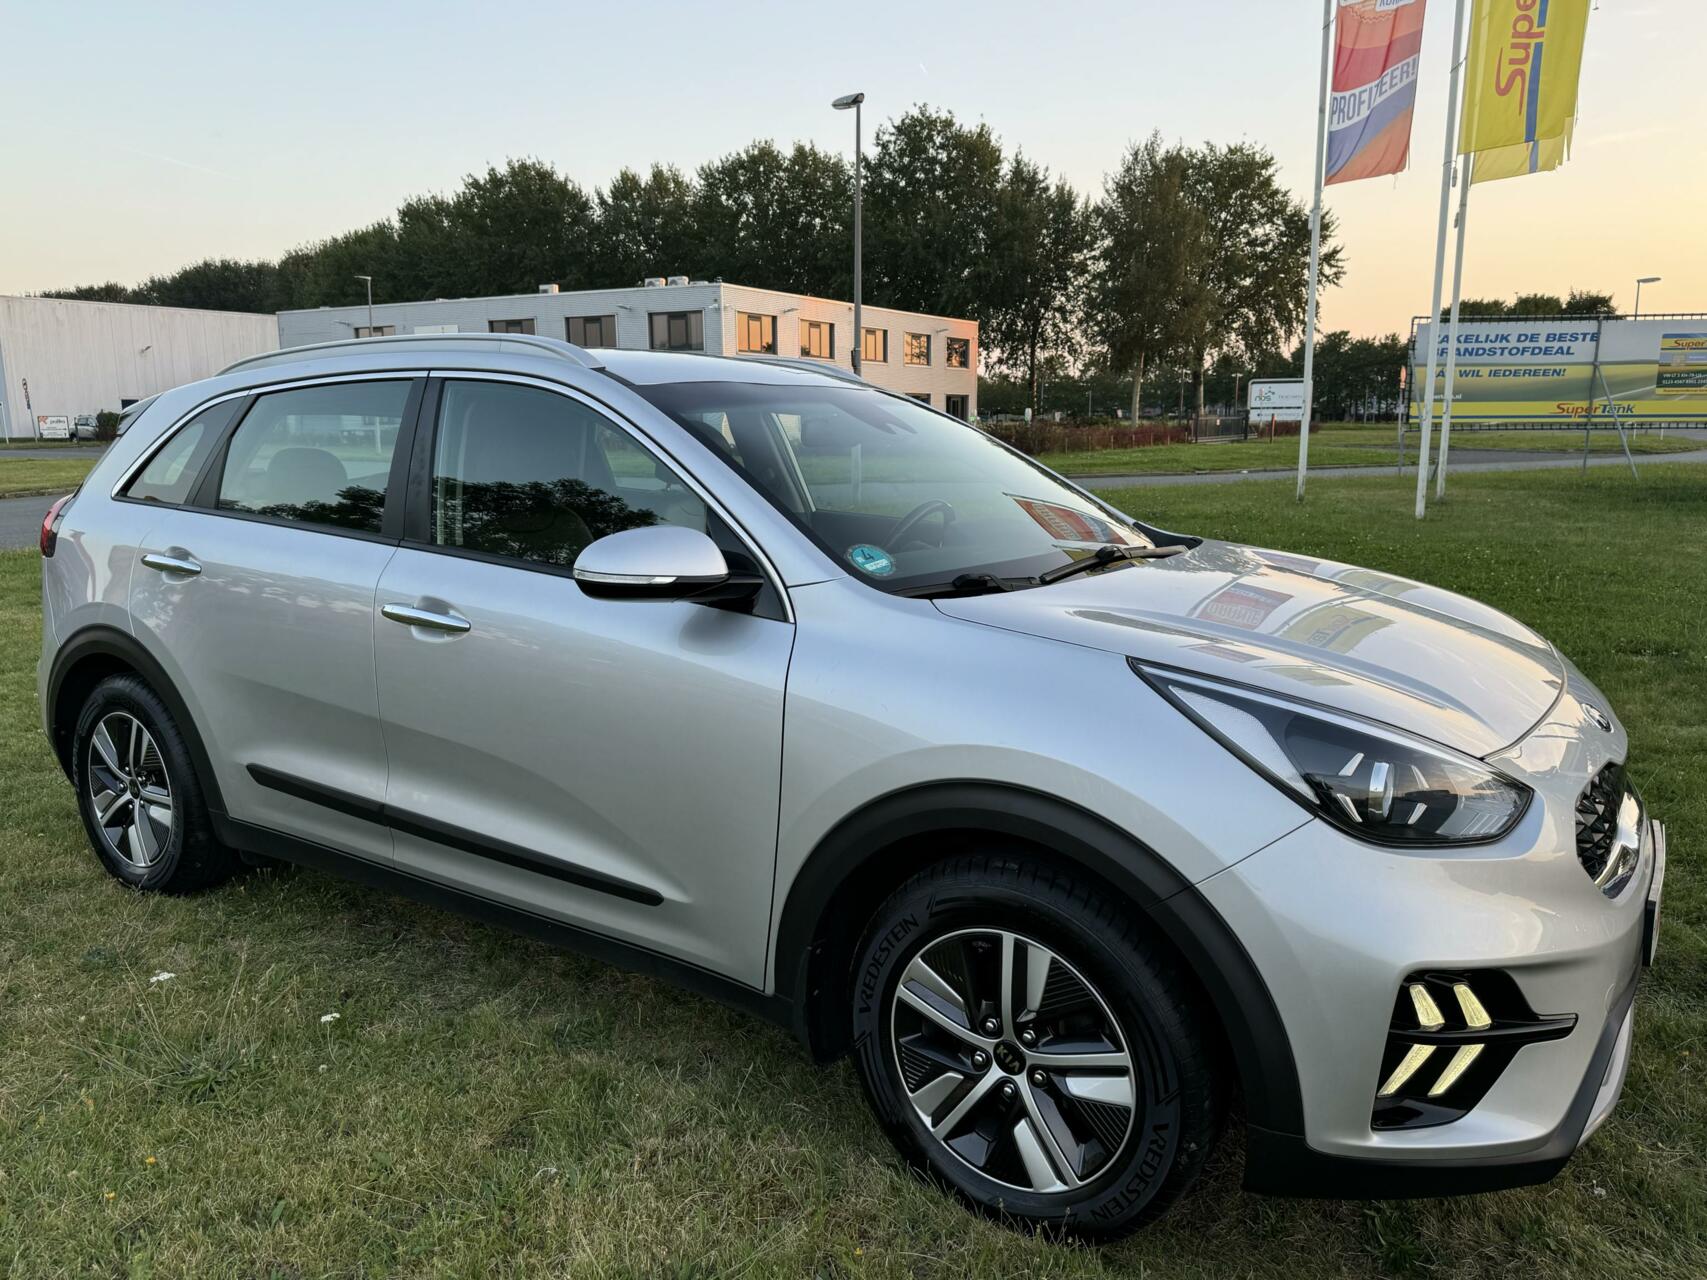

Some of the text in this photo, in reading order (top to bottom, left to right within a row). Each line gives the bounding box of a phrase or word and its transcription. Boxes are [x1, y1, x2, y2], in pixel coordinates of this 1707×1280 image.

[1437, 332, 1601, 345] AKELIJK DE BESTE
[1437, 346, 1576, 357] RANDSTOFDEAL
[1458, 368, 1567, 378] WIL IEDEREEN!
[858, 912, 920, 1014] VREDESTEIN
[1090, 1123, 1169, 1224] VREDESTEIN
